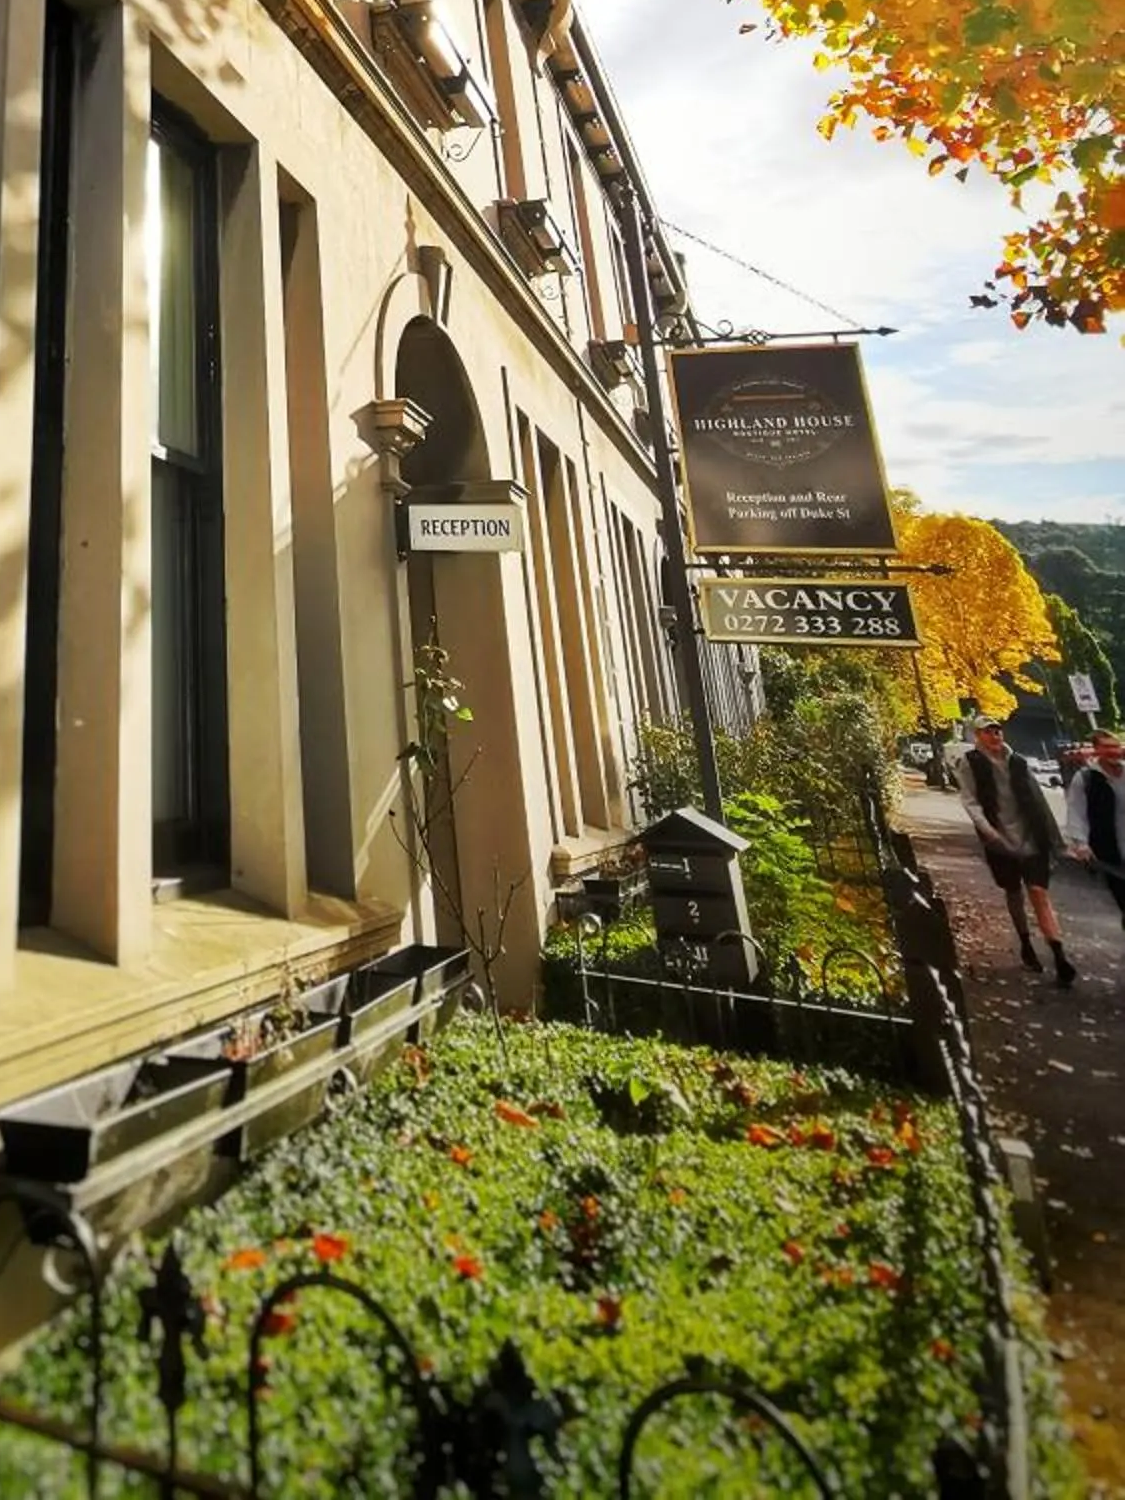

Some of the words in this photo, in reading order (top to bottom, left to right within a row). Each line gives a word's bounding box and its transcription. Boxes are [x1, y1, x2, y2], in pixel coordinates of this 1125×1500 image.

[694, 417, 787, 431] HIGHLAND
[794, 415, 855, 428] HOUSE
[726, 490, 786, 505] Reception
[789, 492, 813, 502] and
[728, 506, 778, 520] Parking
[780, 507, 796, 518] off
[799, 507, 832, 519] Duke
[836, 507, 851, 519] St
[420, 518, 511, 537] RECEPTION
[718, 588, 897, 613] VACANCY
[724, 614, 786, 633] 0272
[794, 615, 843, 634] 333
[851, 616, 902, 636] 288
[687, 900, 700, 917] 2
